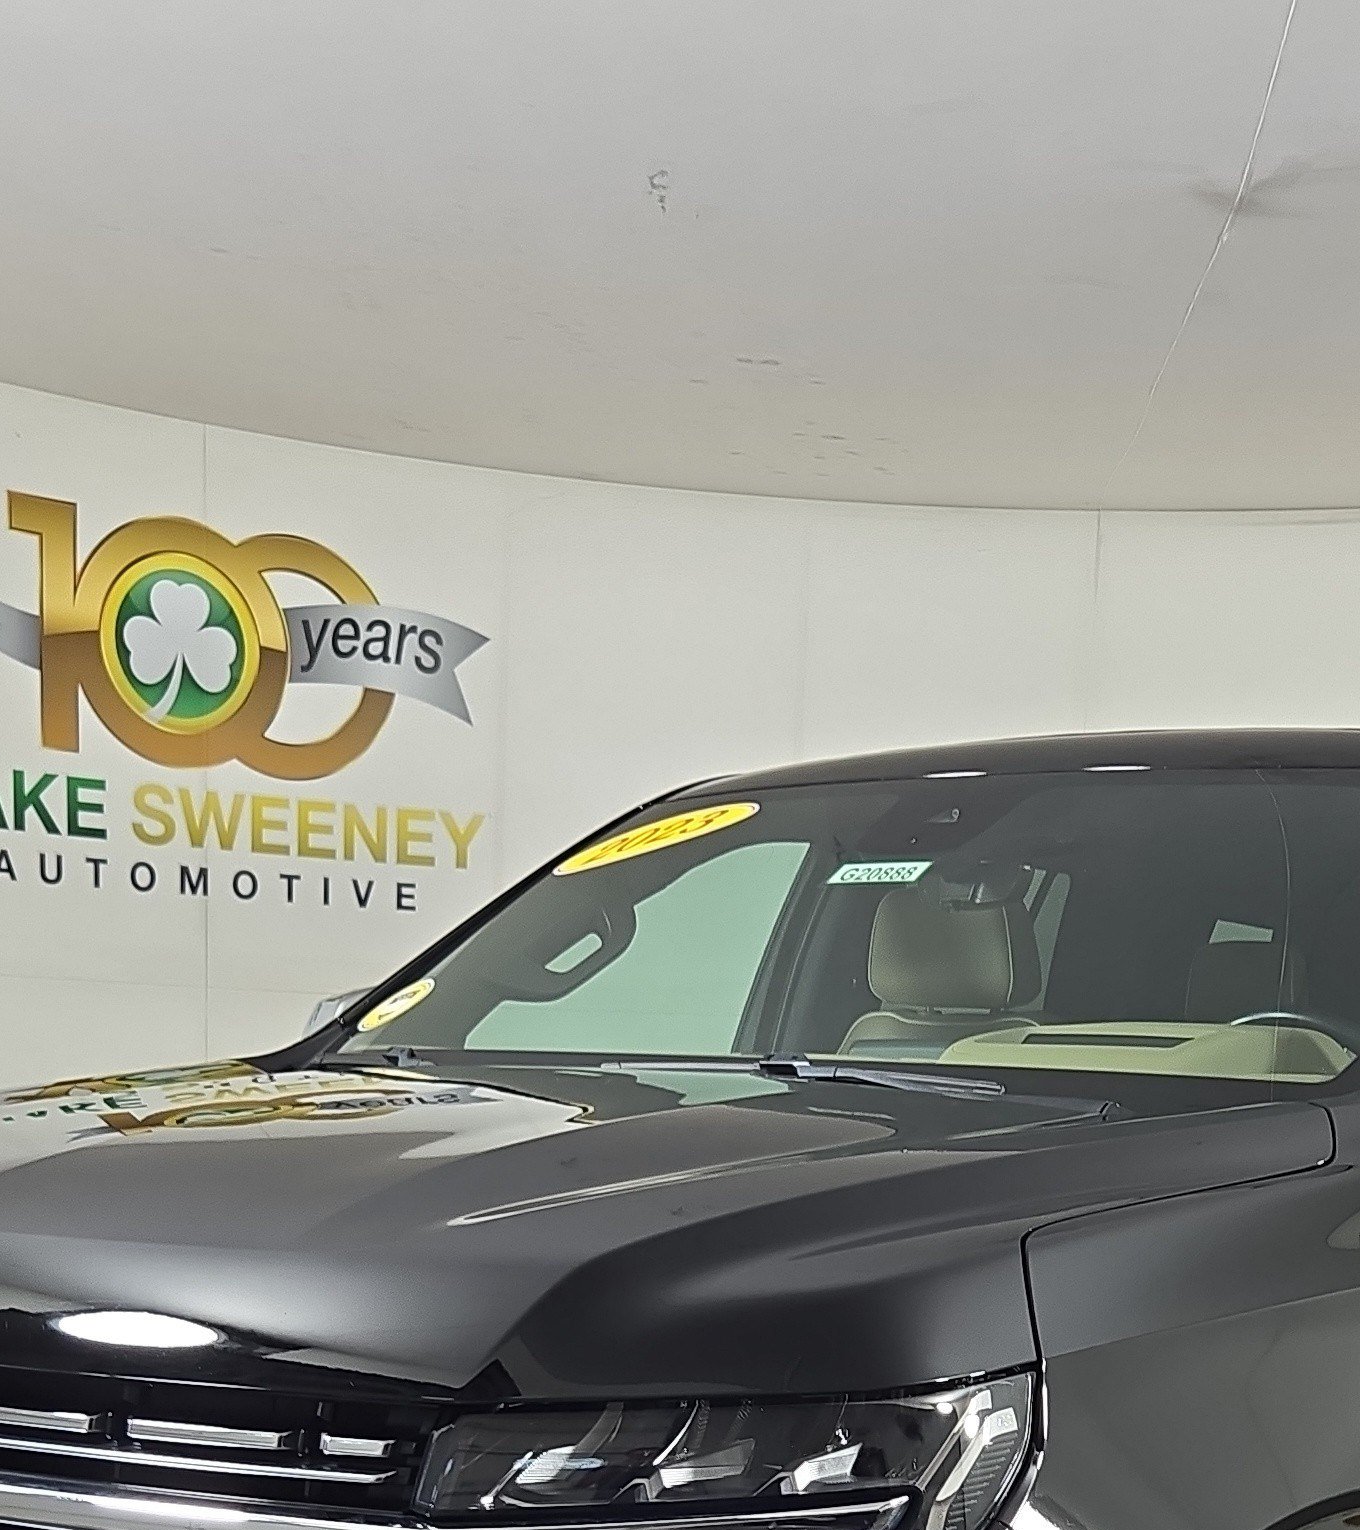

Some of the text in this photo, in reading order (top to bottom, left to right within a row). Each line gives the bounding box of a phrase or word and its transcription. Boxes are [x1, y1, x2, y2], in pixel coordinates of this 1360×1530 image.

[7, 489, 397, 781] 100
[300, 611, 444, 674] years
[131, 784, 486, 869] SWEENEY
[577, 809, 730, 867] 2023
[839, 866, 919, 882] G20888
